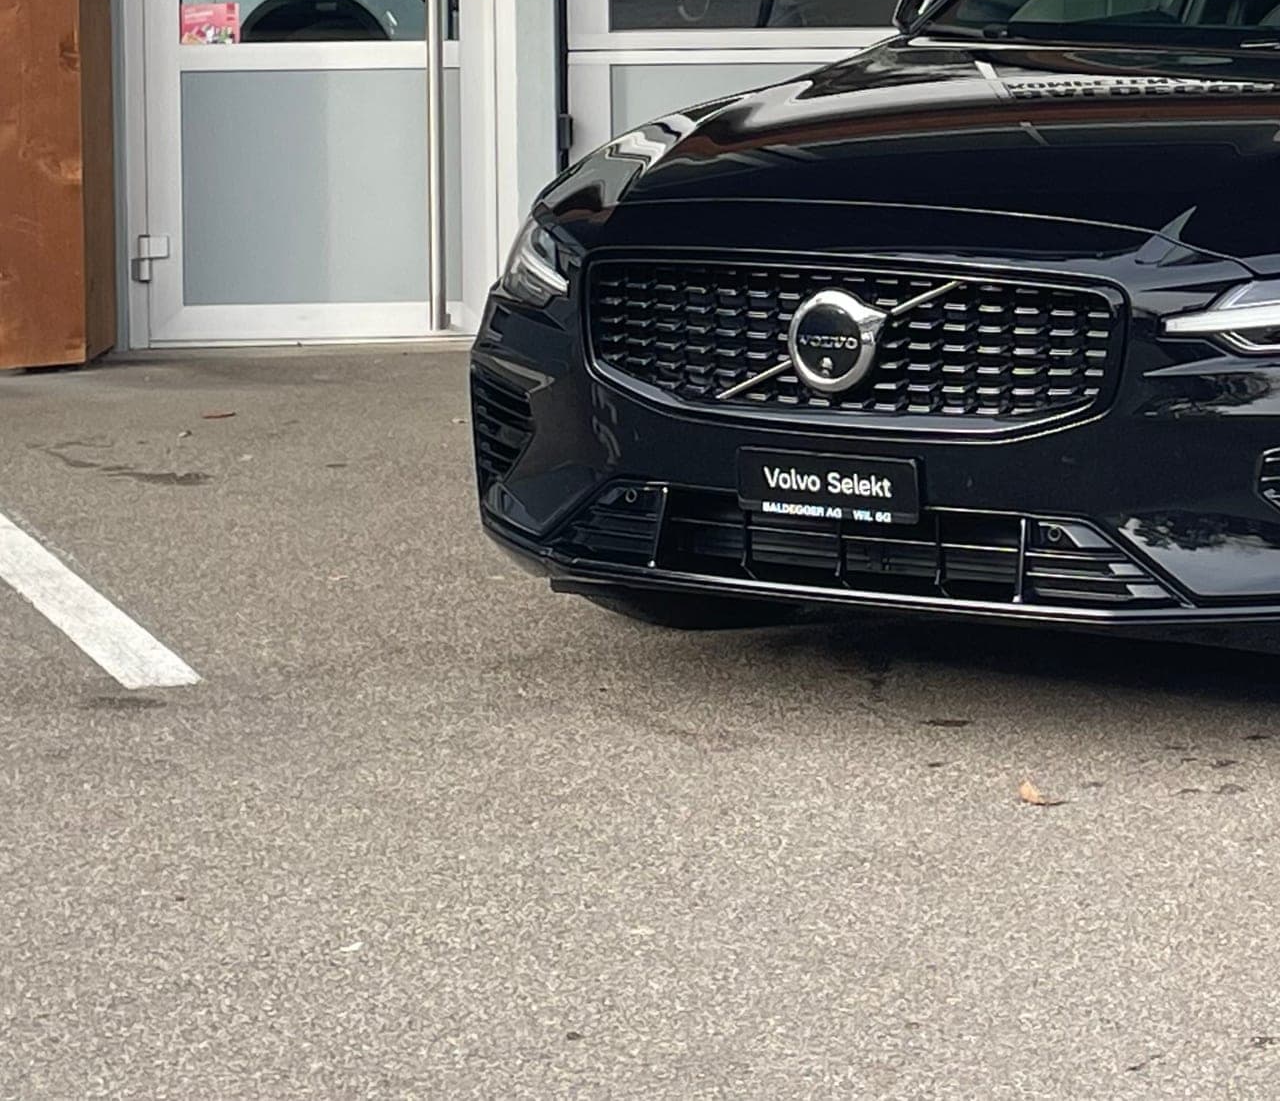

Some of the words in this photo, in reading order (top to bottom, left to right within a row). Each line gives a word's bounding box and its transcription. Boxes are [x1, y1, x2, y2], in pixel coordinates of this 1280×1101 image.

[799, 333, 859, 350] VOLVO
[763, 466, 820, 492] Volvo
[827, 471, 892, 498] Selekt
[826, 507, 842, 519] AG
